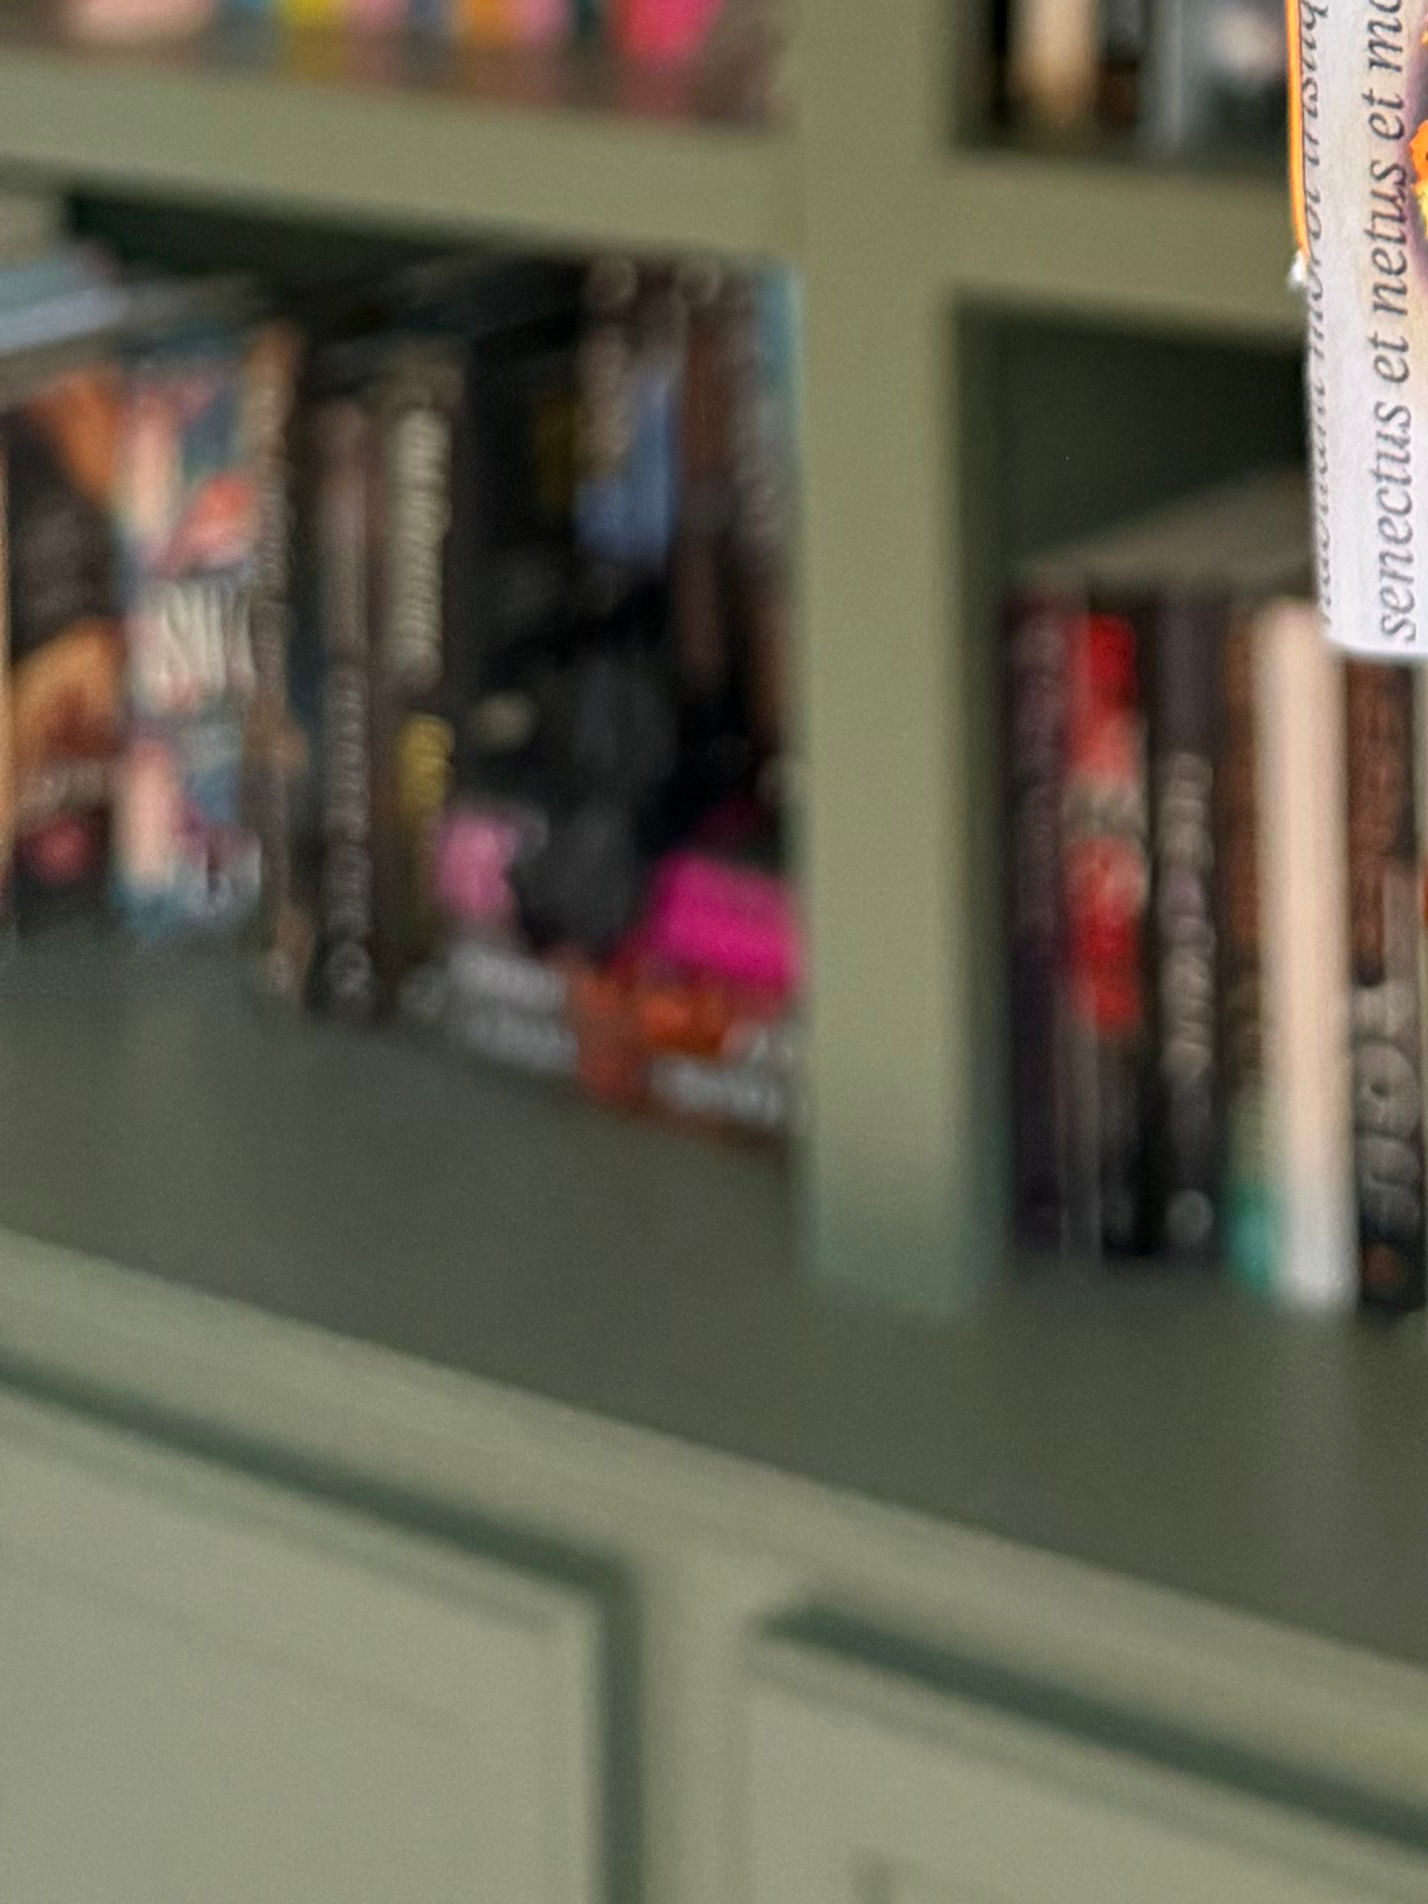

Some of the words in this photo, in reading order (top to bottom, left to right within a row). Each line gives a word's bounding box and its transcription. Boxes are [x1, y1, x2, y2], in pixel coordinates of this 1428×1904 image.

[1363, 90, 1407, 144] et
[1369, 157, 1409, 321] netus
[1371, 336, 1411, 387] et
[1369, 401, 1418, 642] senectus
